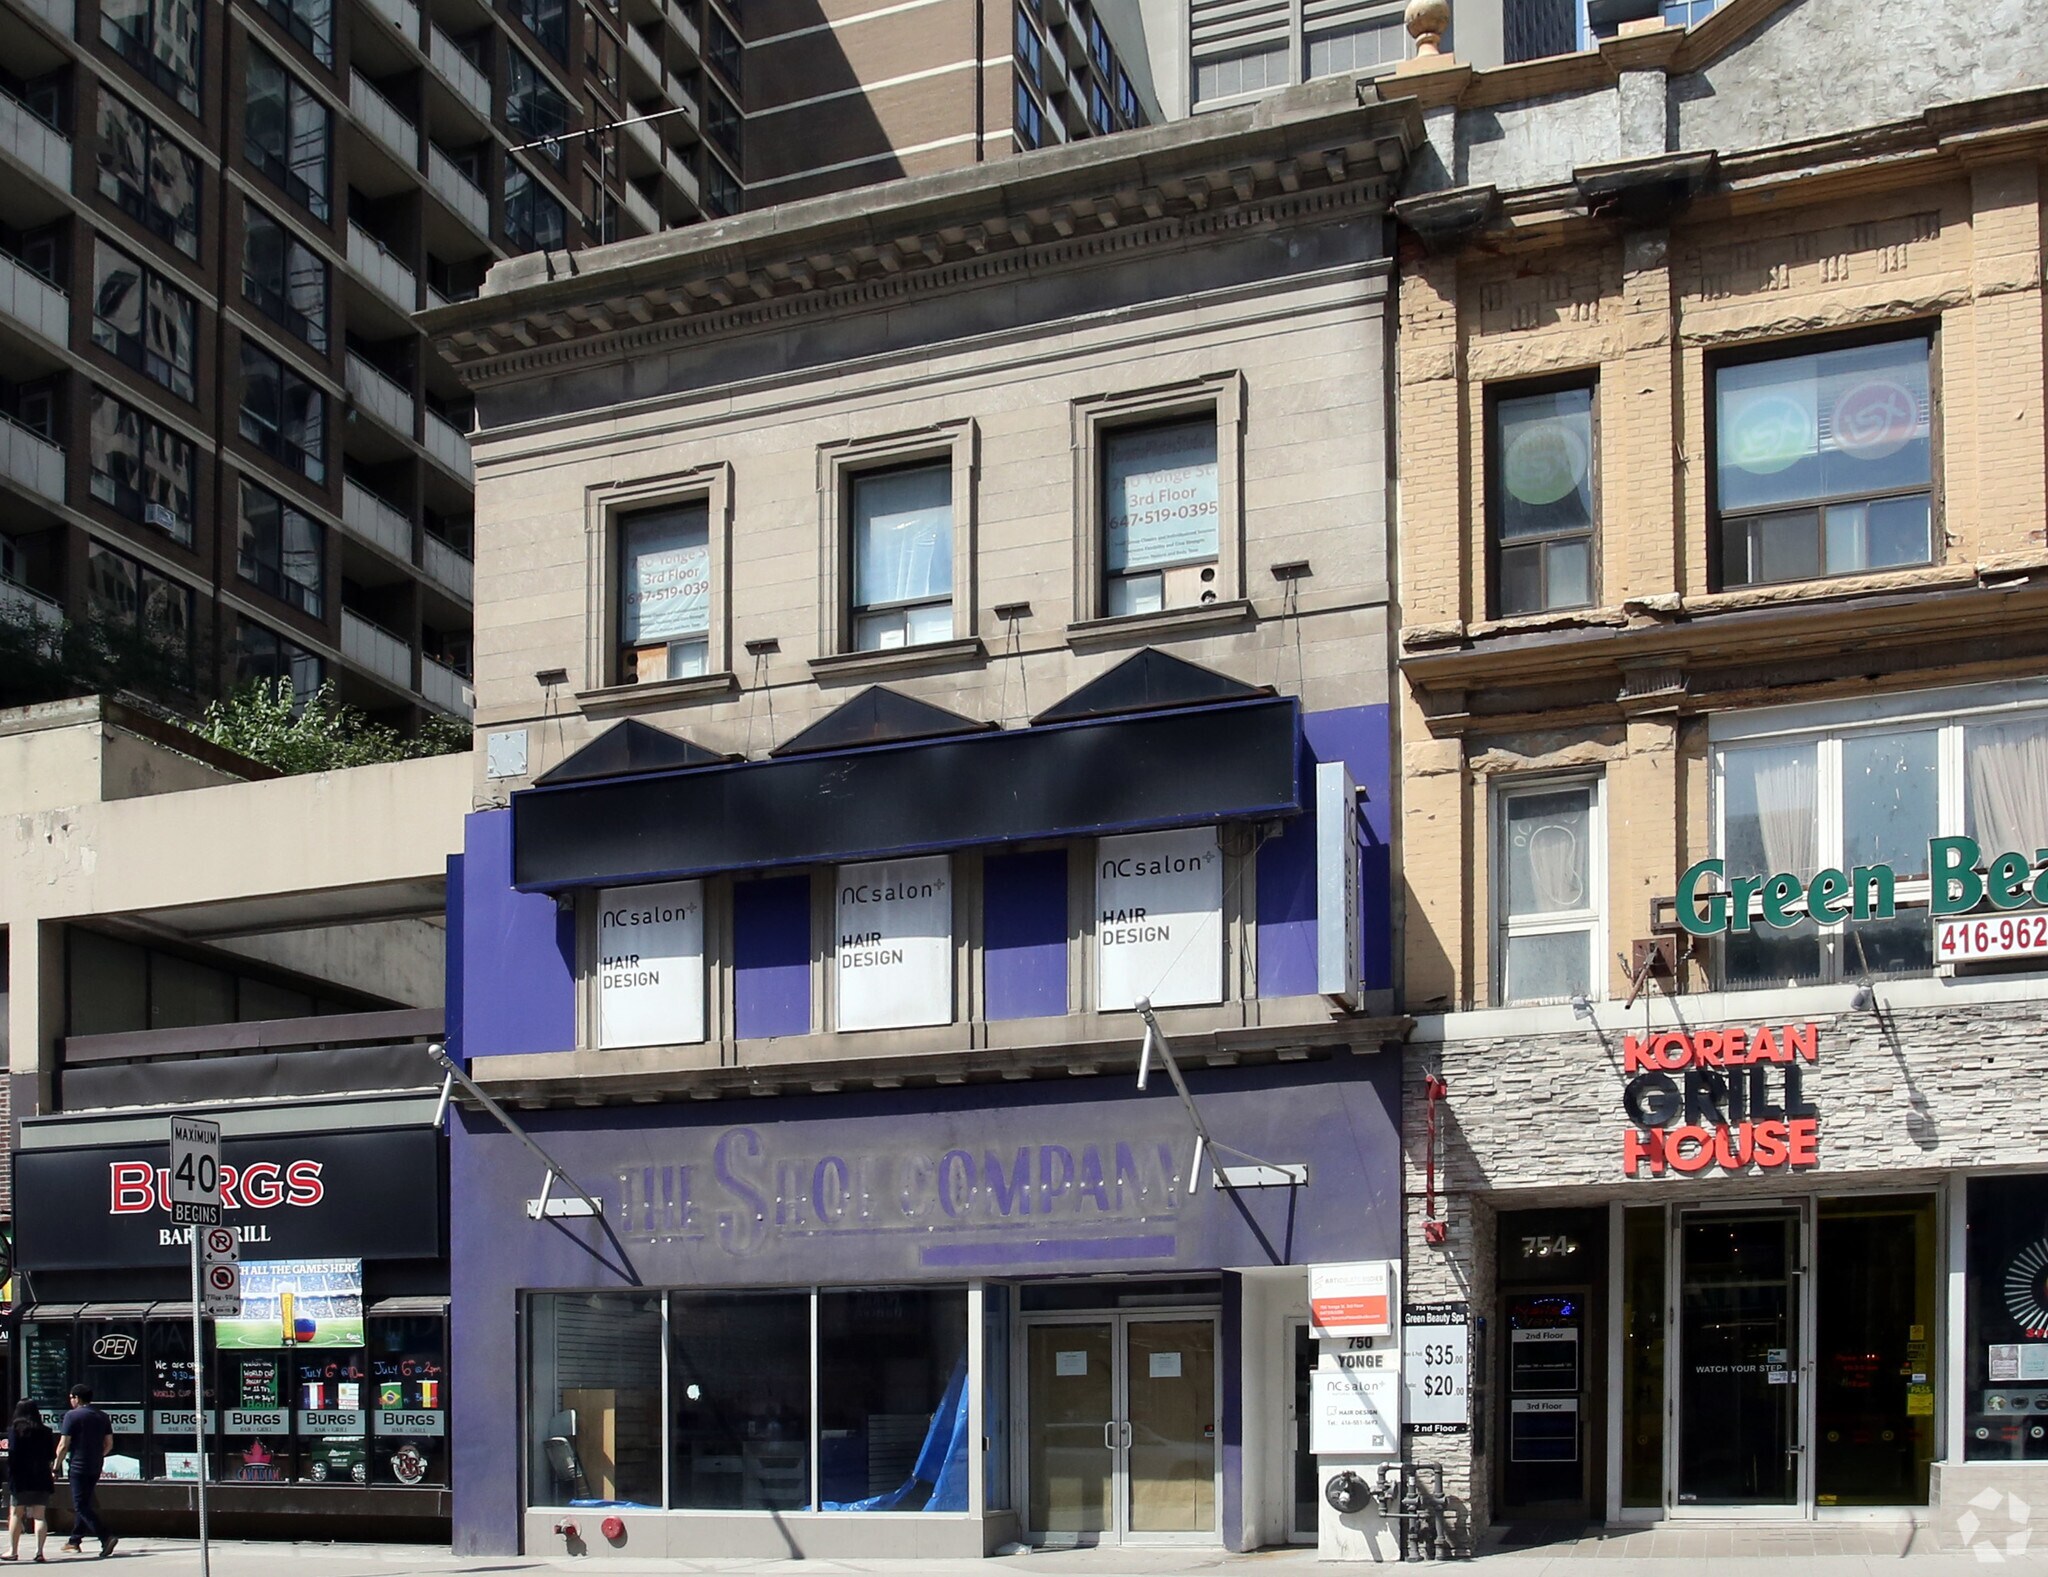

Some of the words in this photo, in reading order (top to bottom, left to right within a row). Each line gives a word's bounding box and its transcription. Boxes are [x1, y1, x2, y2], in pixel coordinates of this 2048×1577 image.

[1130, 492, 1154, 507] 3rd
[1159, 488, 1196, 503] Floor
[644, 572, 664, 586] 3rd
[668, 568, 700, 582] Floor
[1674, 858, 1896, 936] Green
[1102, 908, 1146, 925] HAIR
[842, 932, 882, 948] HAIR
[1102, 926, 1170, 946] DESIGN
[603, 954, 640, 971] HAIR
[842, 950, 903, 969] DESIGN
[603, 971, 660, 990] DESIGN
[1624, 1023, 1818, 1072] KOREAN
[1623, 1064, 1816, 1128] GRILL
[175, 1127, 216, 1145] MAXIMUM
[1623, 1118, 1817, 1174] HOUSE
[175, 1152, 216, 1193] 40
[176, 1204, 217, 1223] BEGINS
[238, 1225, 271, 1243] RILL
[1522, 1236, 1569, 1258] 754
[251, 1266, 269, 1275] ALL
[271, 1265, 291, 1274] THE
[293, 1264, 328, 1274] GAMES
[330, 1263, 358, 1273] HERE
[1405, 1313, 1425, 1323] Green
[1427, 1313, 1450, 1324] Beauty
[1452, 1312, 1464, 1324] Spa
[92, 1339, 137, 1355] OPEN
[1348, 1337, 1373, 1349] 750
[155, 1360, 168, 1370] We
[374, 1362, 398, 1375] JULY
[1338, 1355, 1383, 1368] YONGE
[264, 1369, 275, 1377] CUP
[300, 1366, 321, 1379] JULY
[232, 1413, 280, 1425] BURGS
[307, 1413, 356, 1425] BURGS
[384, 1413, 435, 1425] BURGS
